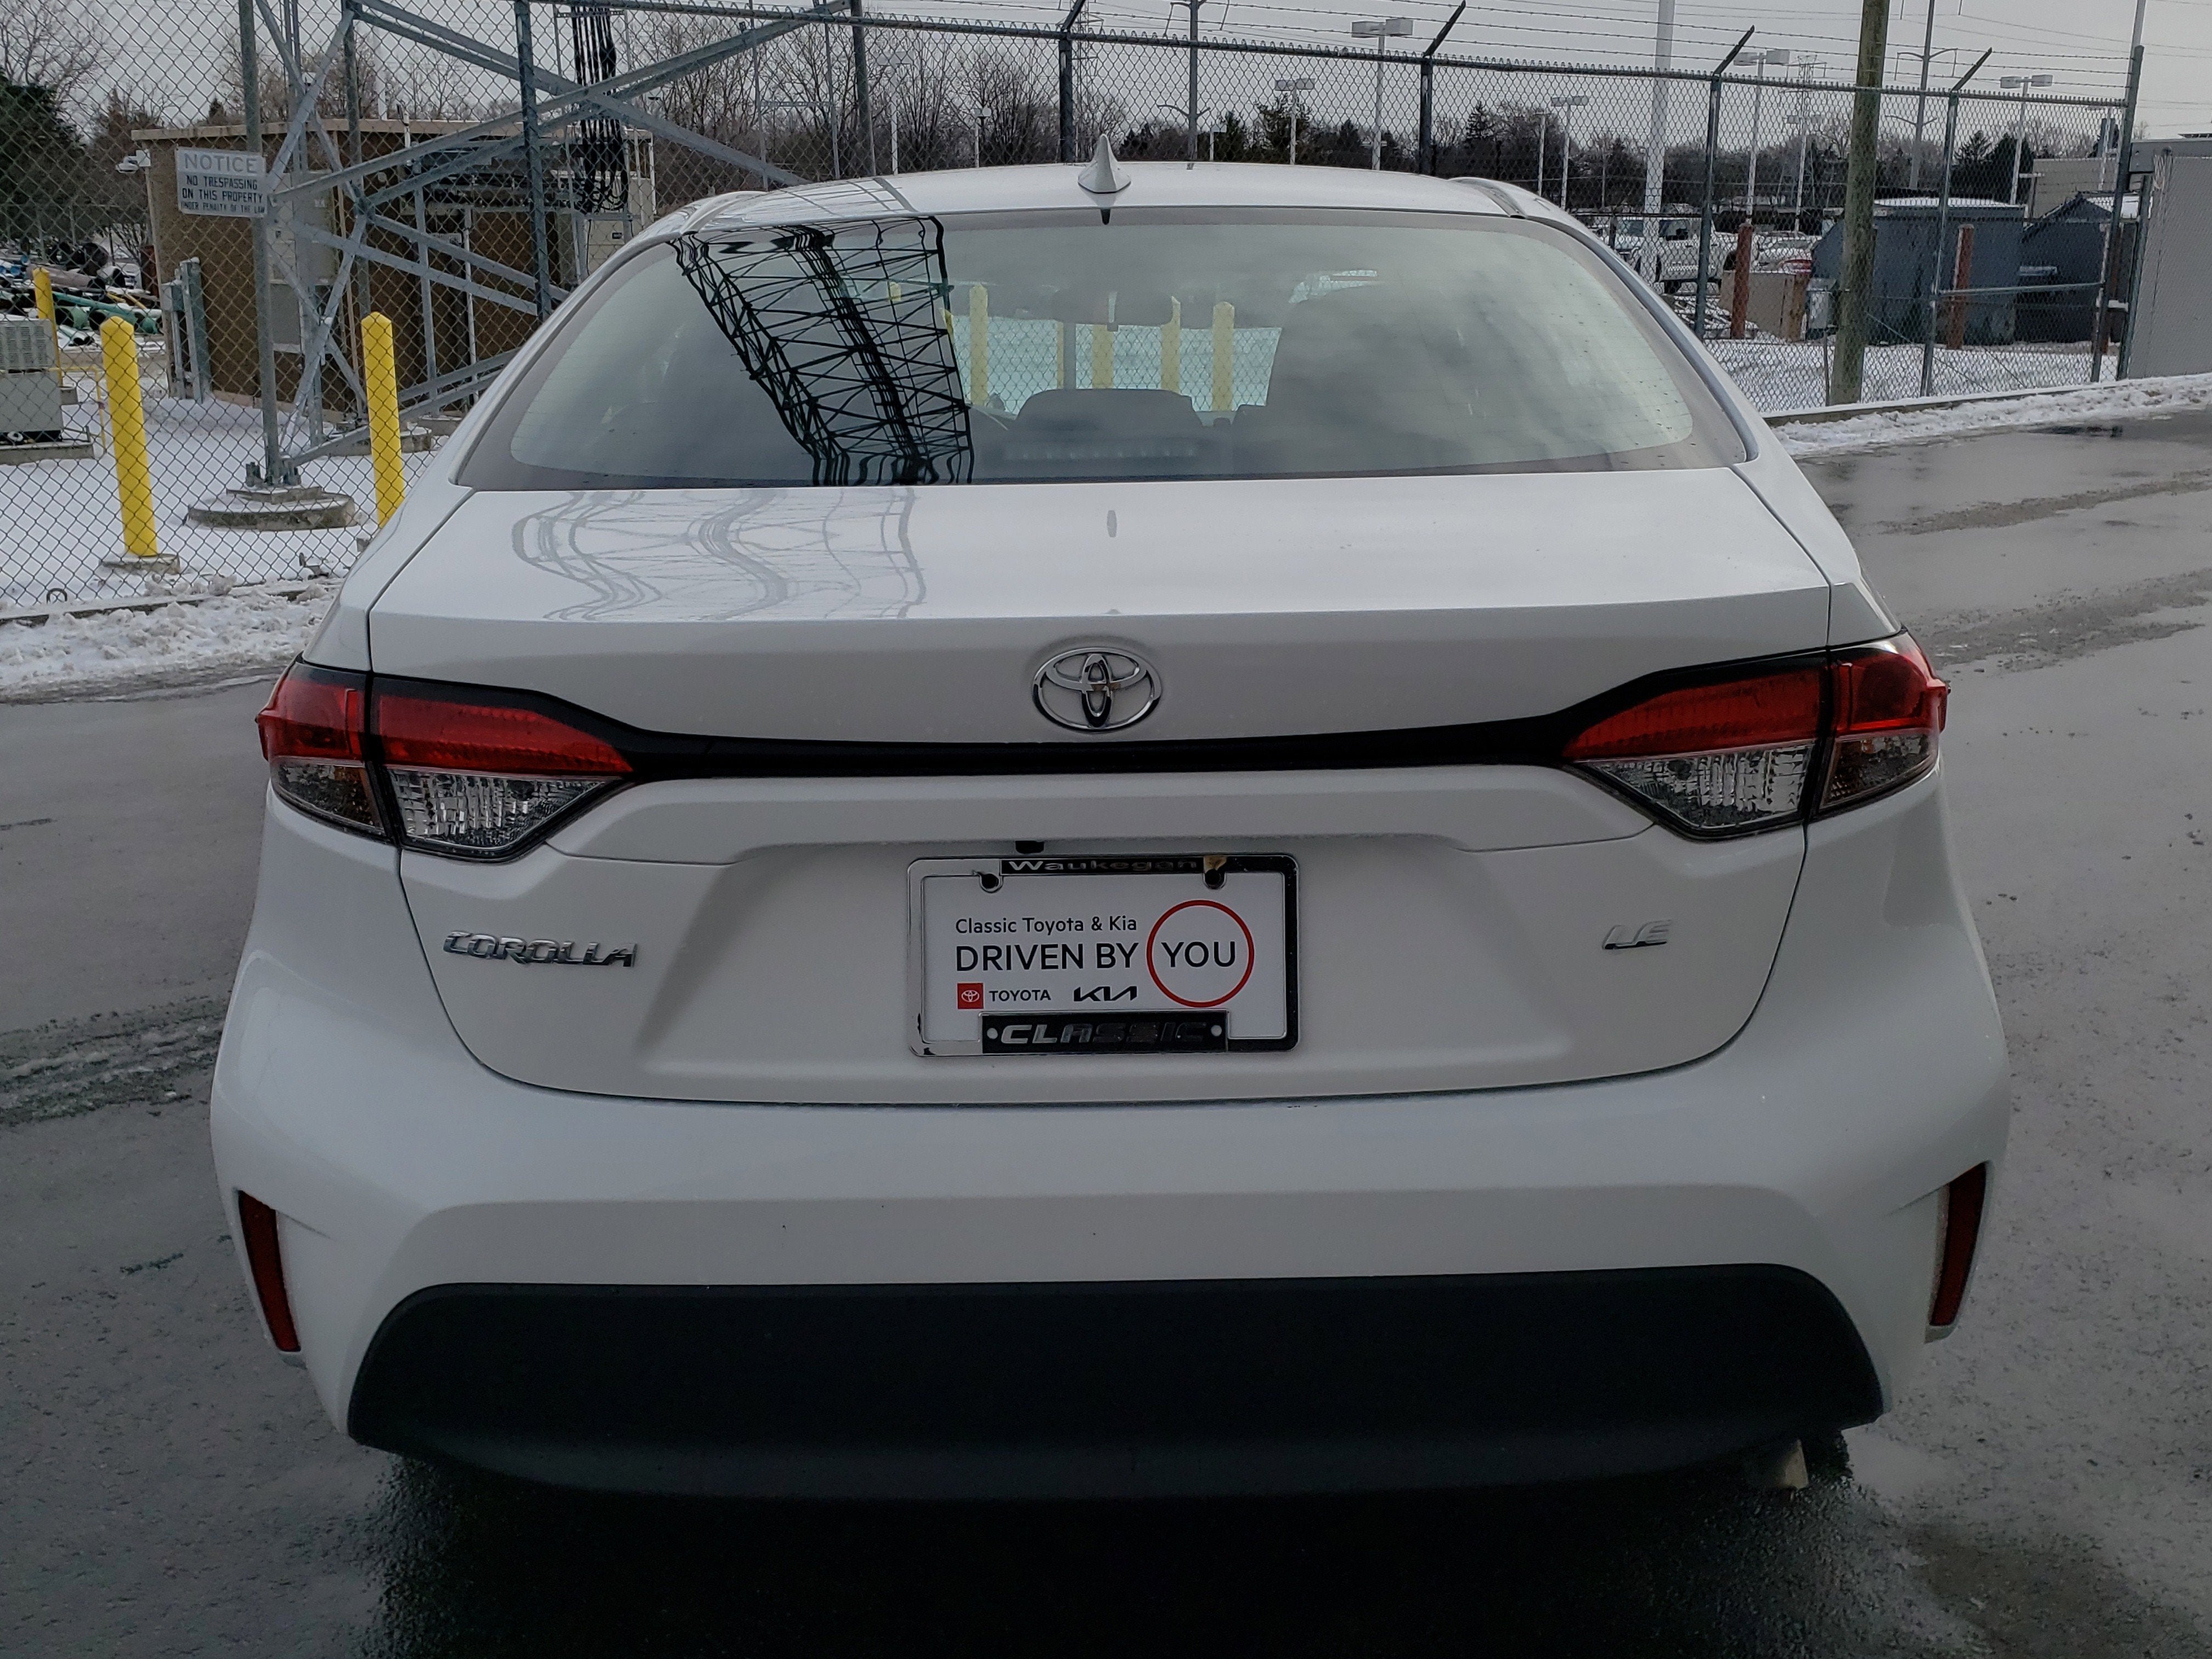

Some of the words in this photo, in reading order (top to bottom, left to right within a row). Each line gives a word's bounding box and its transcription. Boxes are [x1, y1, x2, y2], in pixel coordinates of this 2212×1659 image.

[184, 153, 257, 173] NOTICE
[187, 175, 198, 186] NO
[204, 176, 257, 190] TRESPASSING
[182, 188, 194, 199] ON
[199, 189, 218, 201] THIS
[222, 191, 263, 204] PROPERTY
[1008, 859, 1198, 872] Waukegan
[955, 918, 1017, 933] Classic
[1022, 917, 1084, 936] Toyota
[1091, 916, 1103, 932] &
[1109, 915, 1137, 931] Kia
[1601, 919, 1672, 950] LE
[443, 930, 637, 968] COROLLA
[956, 944, 1084, 972] DRIVEN
[1096, 943, 1139, 969] BY
[1161, 941, 1236, 968] YOU
[989, 989, 1052, 1002] TOYOTA
[1073, 985, 1137, 1002] KIA
[1001, 1022, 1209, 1044] CLASSIC
